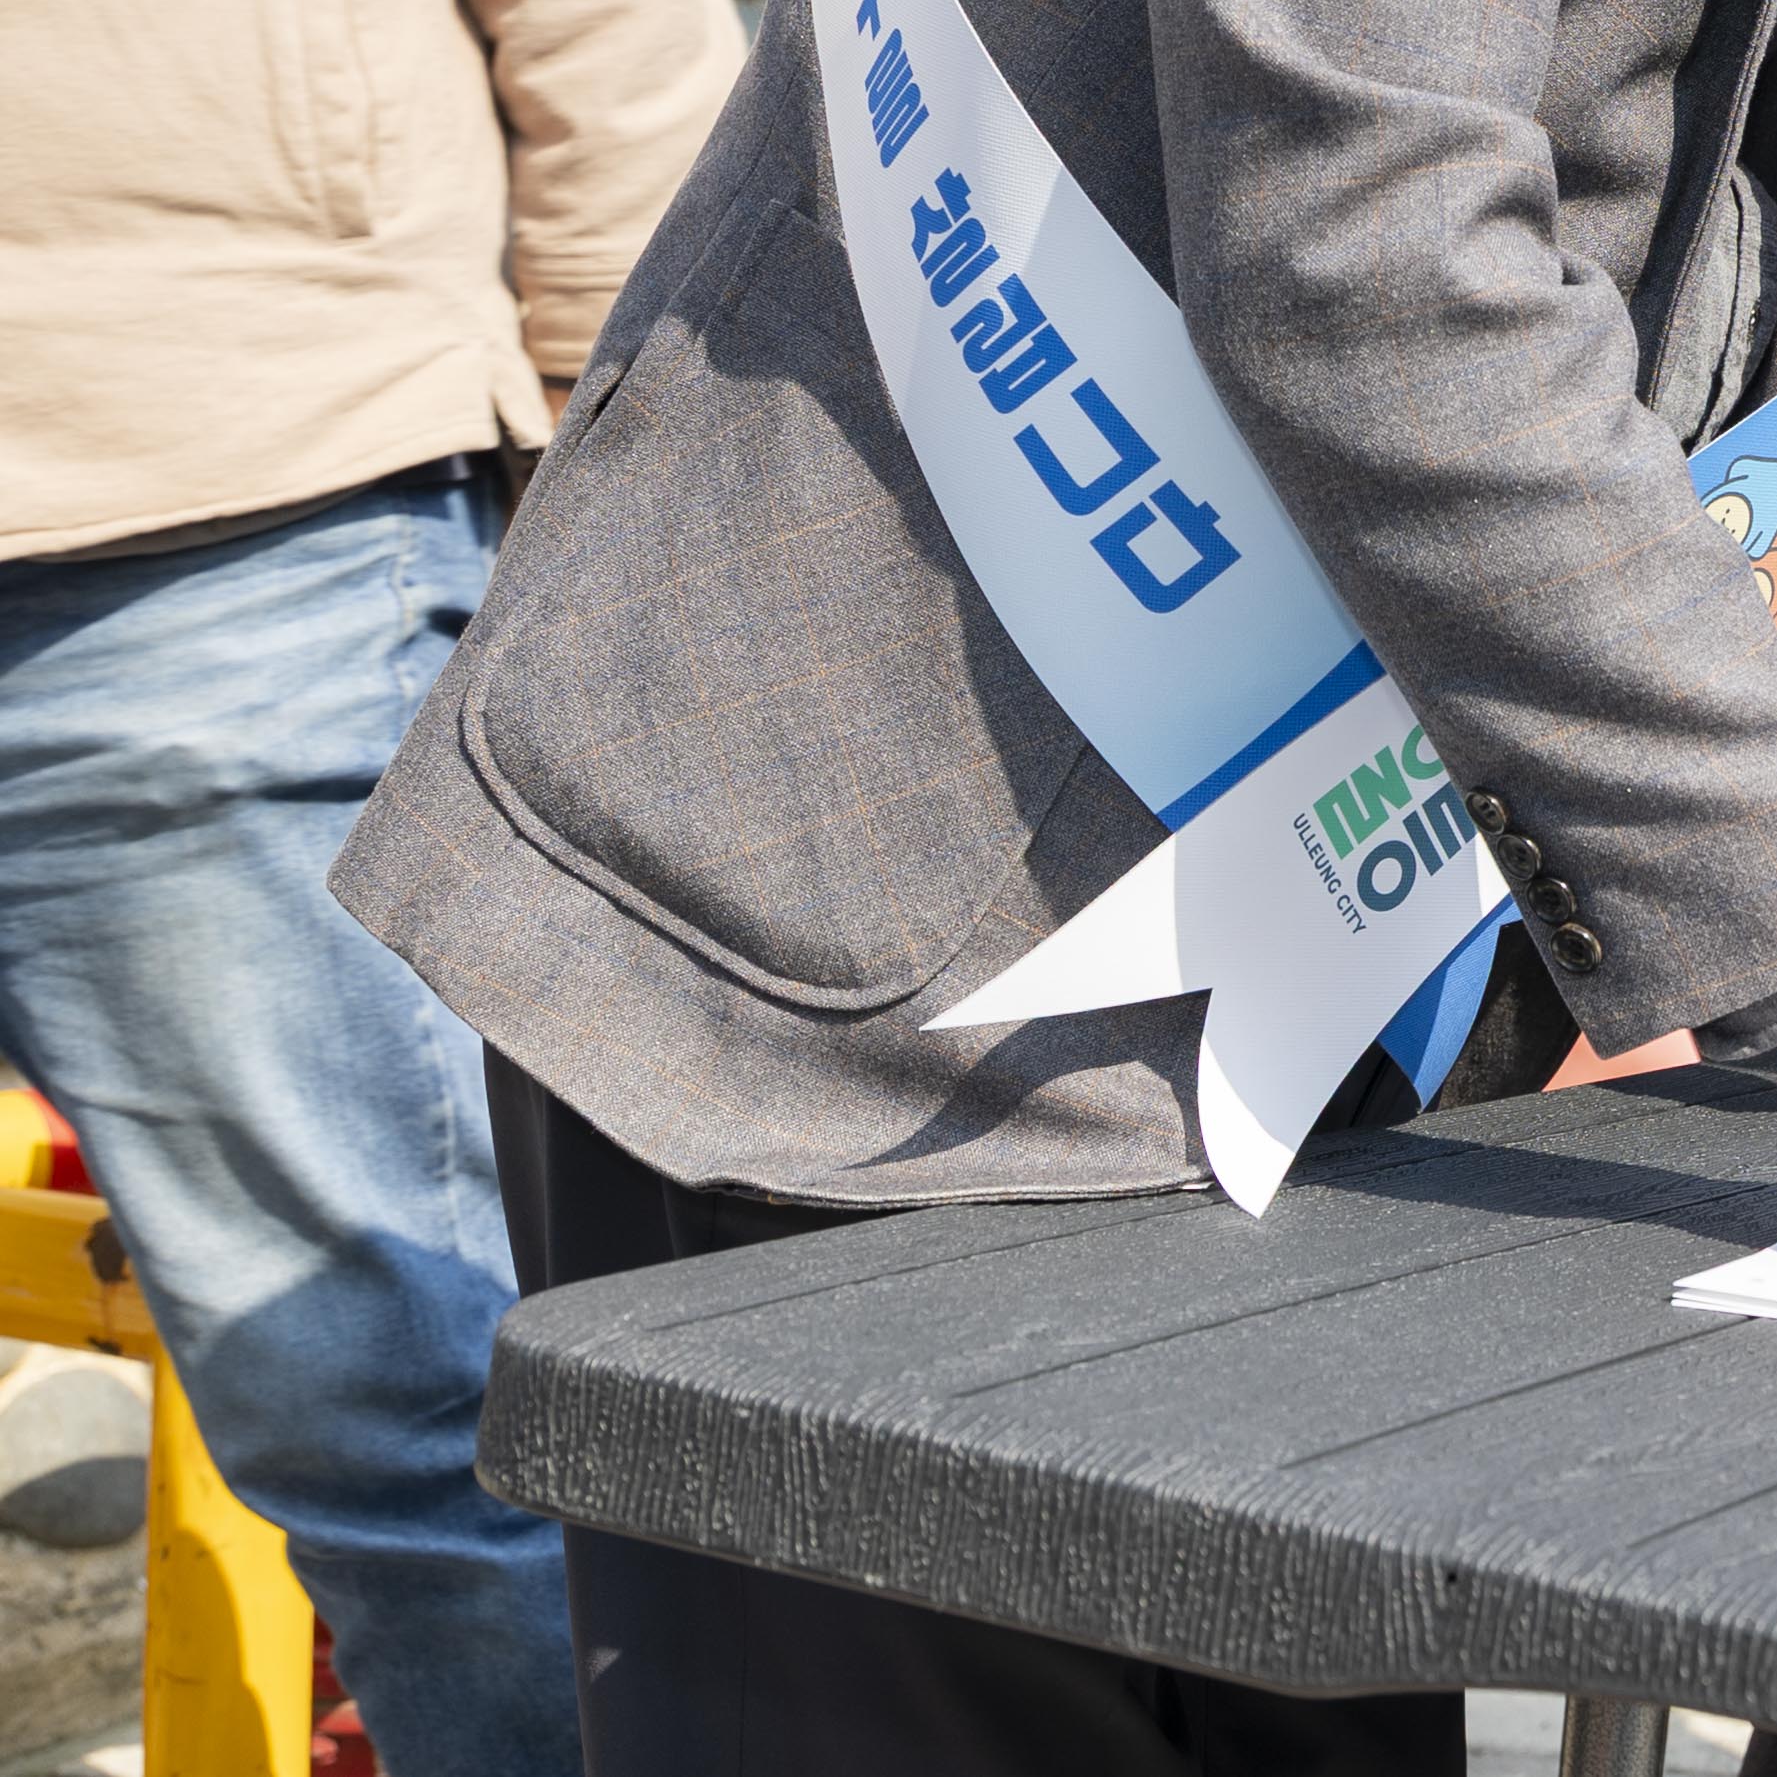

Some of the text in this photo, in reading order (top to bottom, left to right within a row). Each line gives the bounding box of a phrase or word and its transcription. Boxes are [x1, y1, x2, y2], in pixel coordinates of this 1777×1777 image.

[908, 165, 1244, 616] 살립니다
[1293, 812, 1367, 934] ULLEUNG CITY
